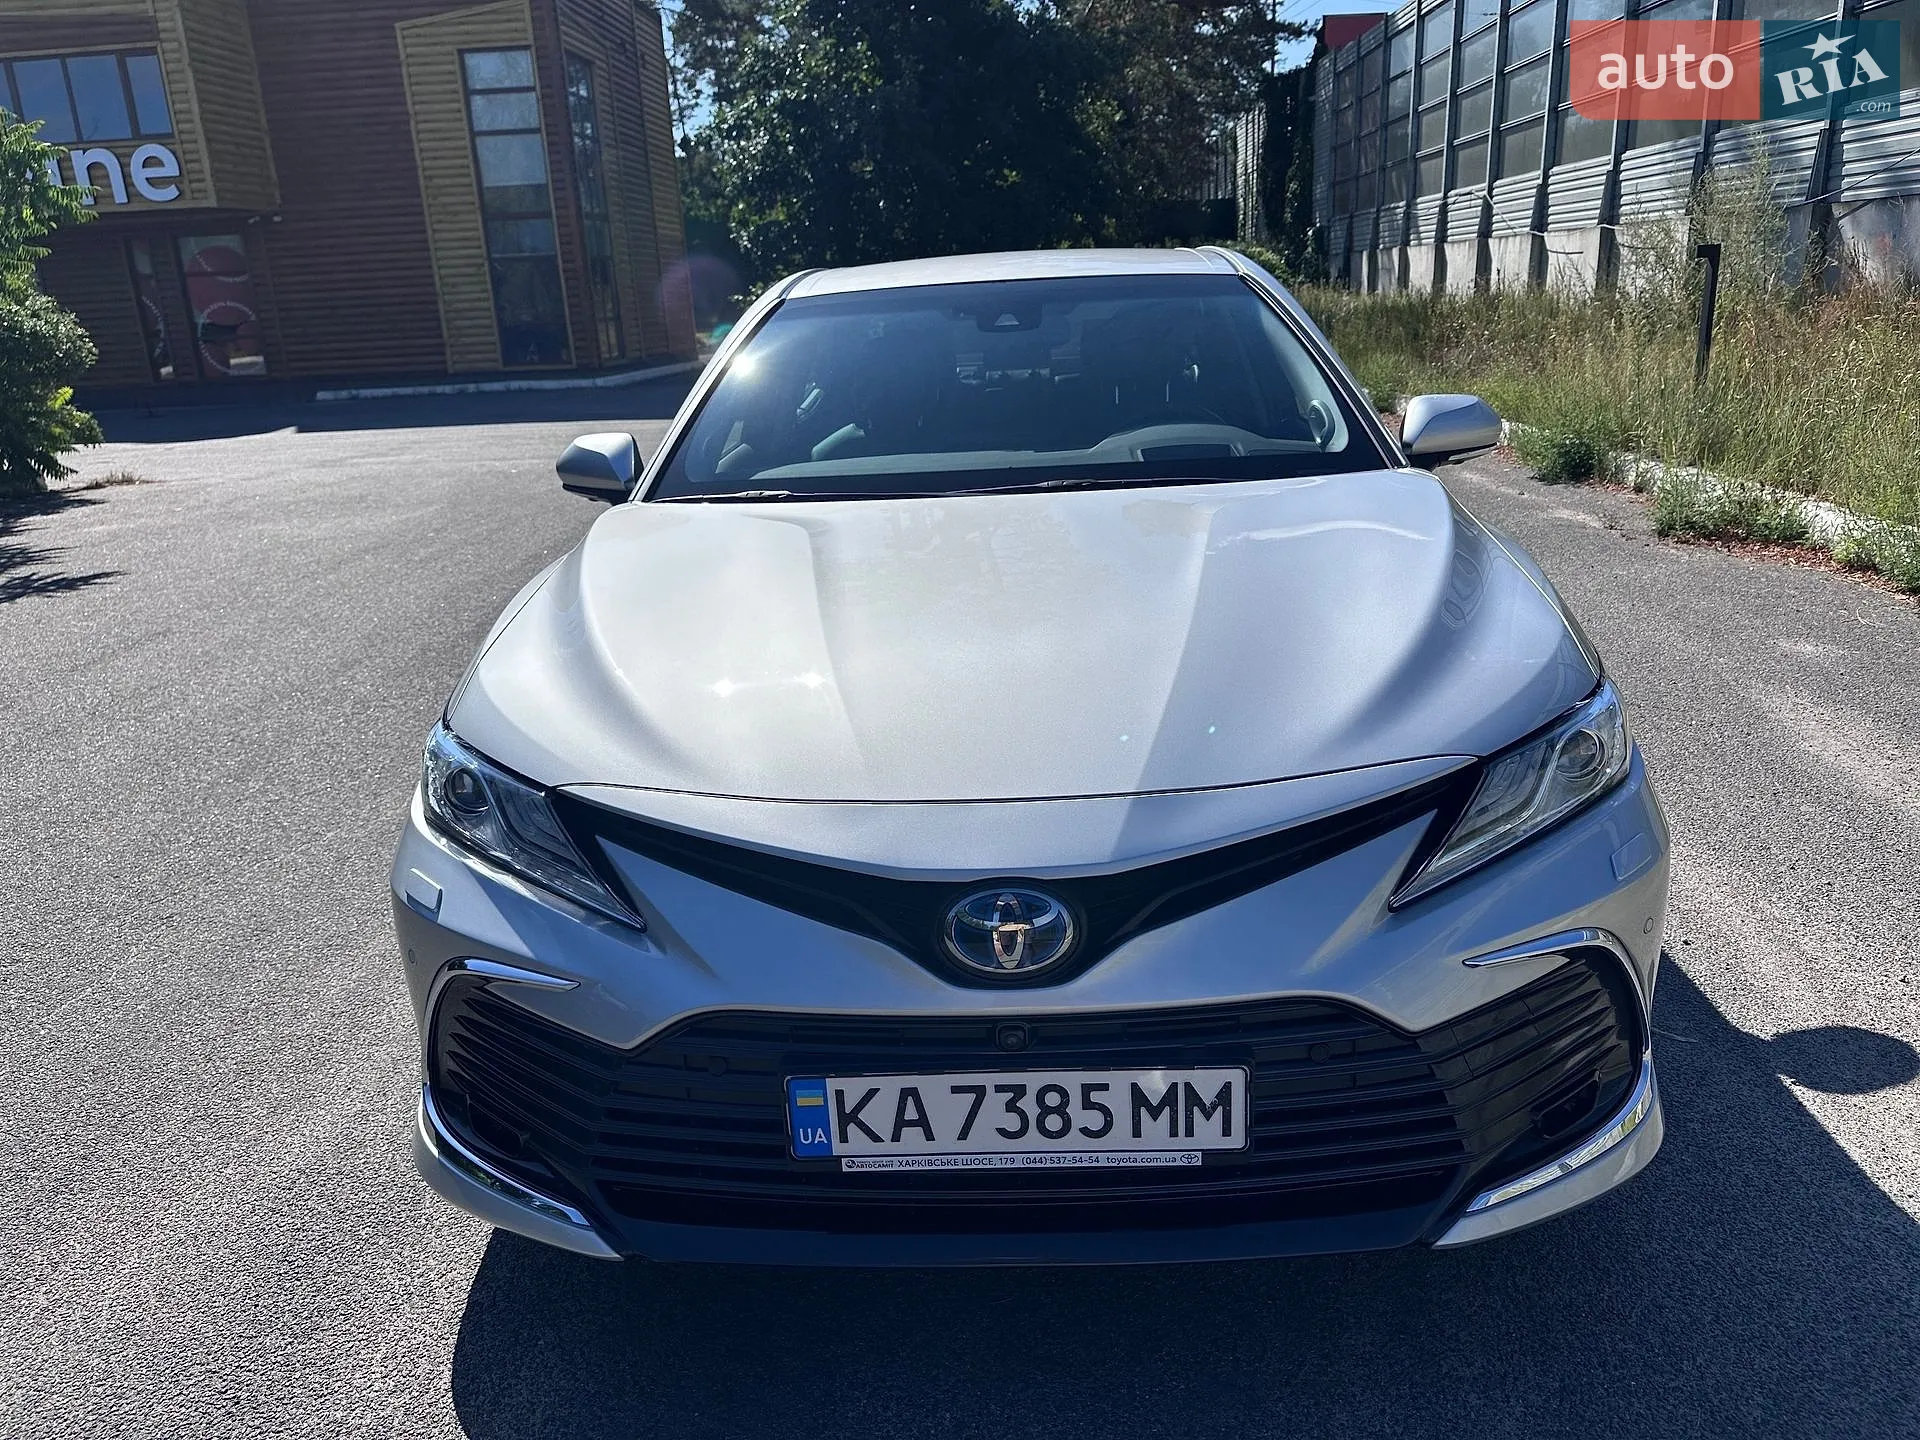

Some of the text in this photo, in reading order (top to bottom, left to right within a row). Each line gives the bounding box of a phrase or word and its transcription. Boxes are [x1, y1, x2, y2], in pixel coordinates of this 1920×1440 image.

[834, 1081, 1232, 1144] KA 7385 MM
[799, 1128, 828, 1145] UA
[897, 1155, 1177, 1168] ХАРКІВСЬКЕ ШОСЕ, 179 (044) 537-54-54 toyota.com.ua
